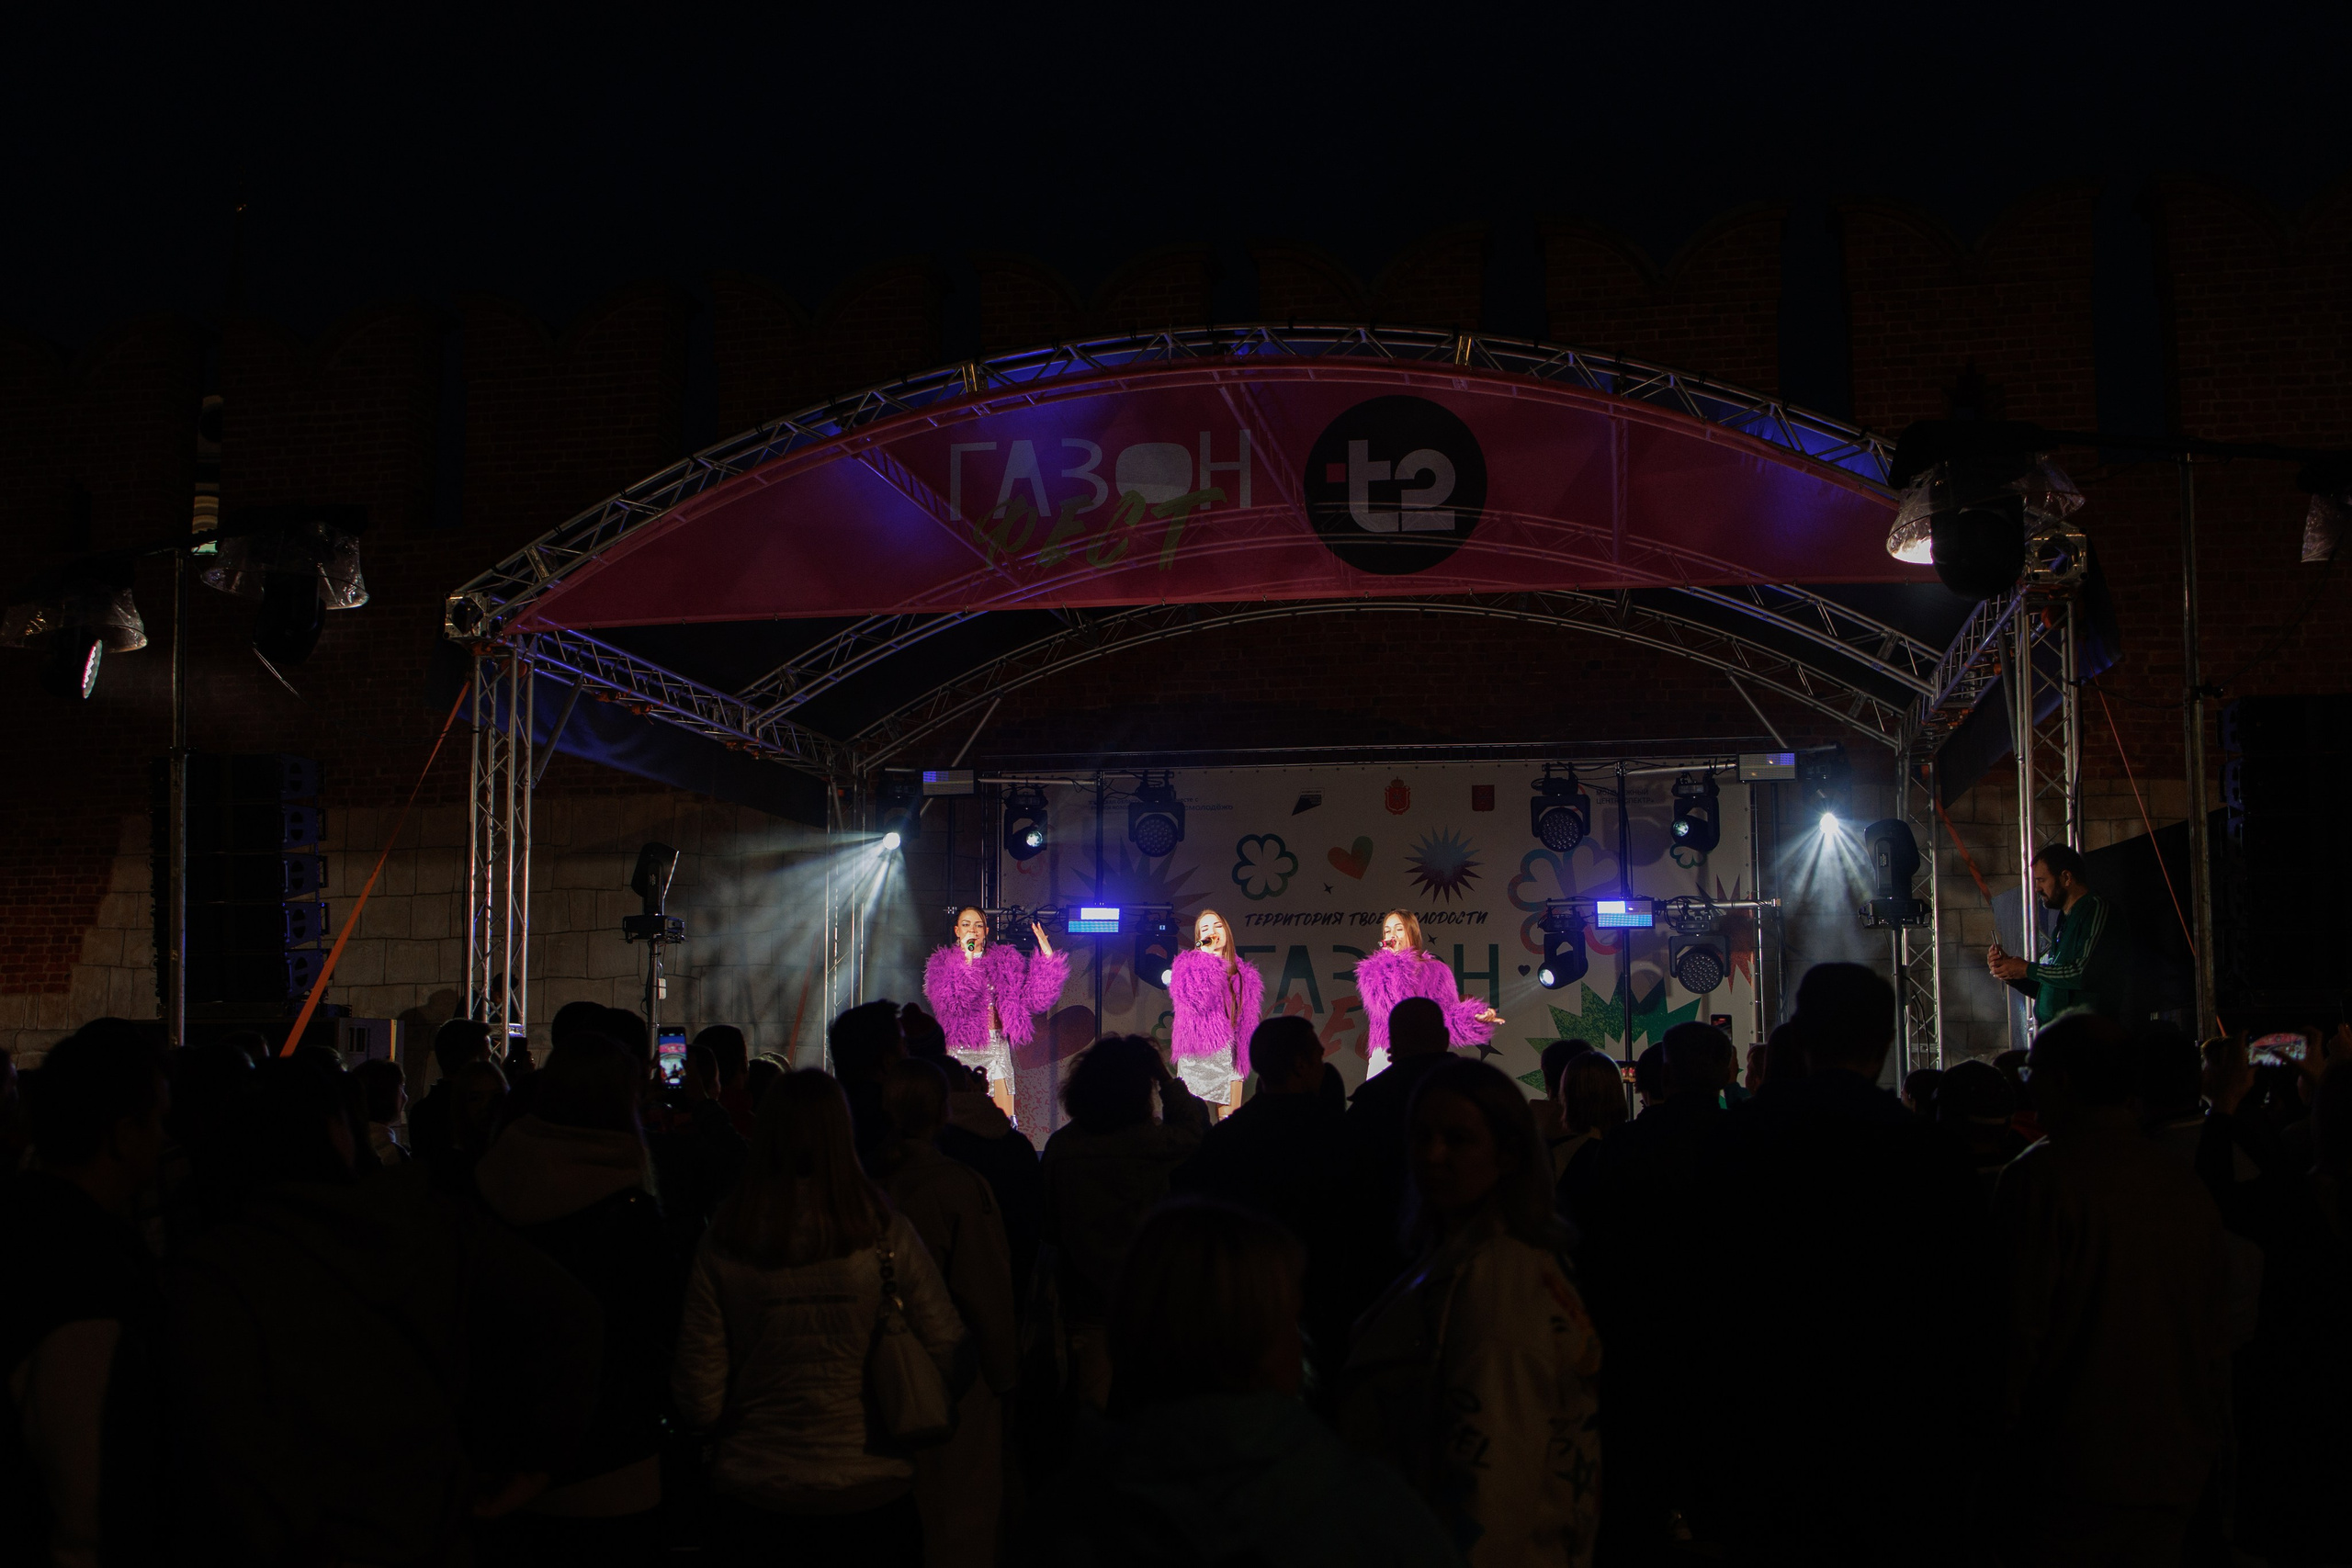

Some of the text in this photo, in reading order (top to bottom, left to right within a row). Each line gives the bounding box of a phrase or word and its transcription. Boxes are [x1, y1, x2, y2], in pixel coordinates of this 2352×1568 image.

[949, 428, 1251, 521] ГАЗОН
[1347, 439, 1456, 533] t2
[973, 487, 1227, 571] ФЕСТ
[1244, 912, 1344, 927] ТЕРРИТОРИЯ
[1349, 908, 1396, 926] ТВОЕ
